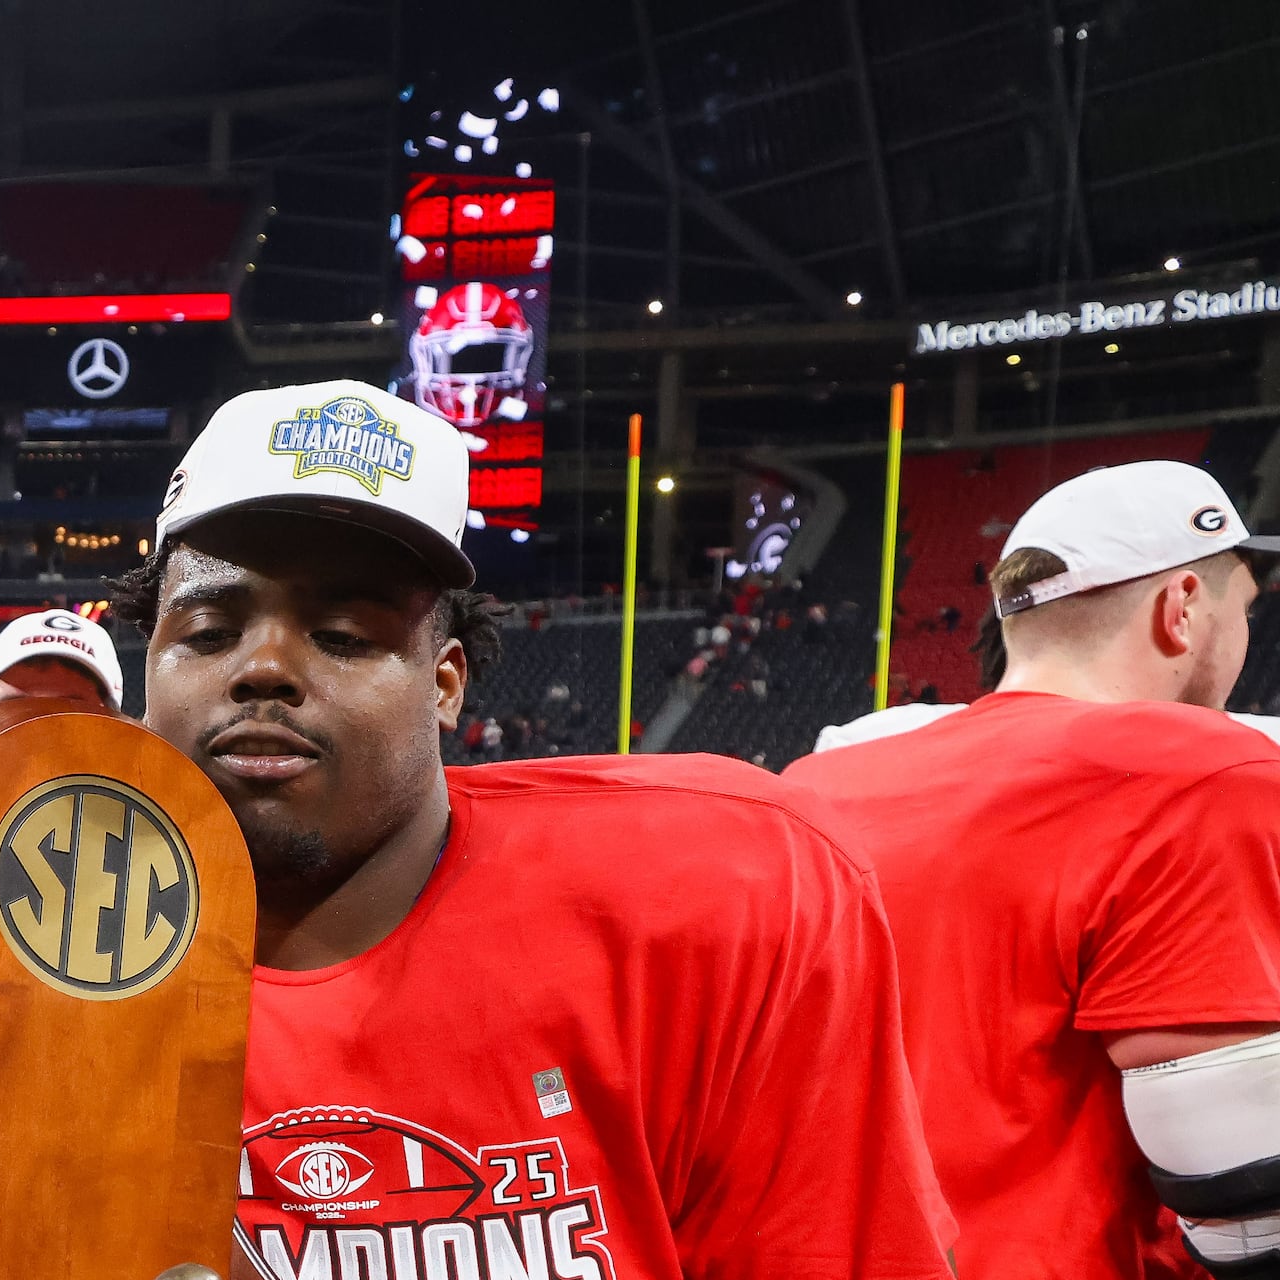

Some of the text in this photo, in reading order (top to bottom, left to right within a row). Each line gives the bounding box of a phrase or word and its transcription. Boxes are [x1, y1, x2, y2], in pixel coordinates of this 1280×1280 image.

[914, 280, 1280, 354] Mercedes-Benz Stadiu
[302, 409, 396, 435] 20 25
[338, 402, 364, 424] SEC
[275, 422, 414, 475] CHAMPIONS
[310, 451, 372, 476] FOOTBALL
[20, 634, 96, 658] GEORGIA
[6, 792, 180, 984] SEC
[303, 1153, 345, 1196] SEC
[489, 1151, 557, 1205] 25
[281, 1200, 381, 1212] CHAMPIONSHIP
